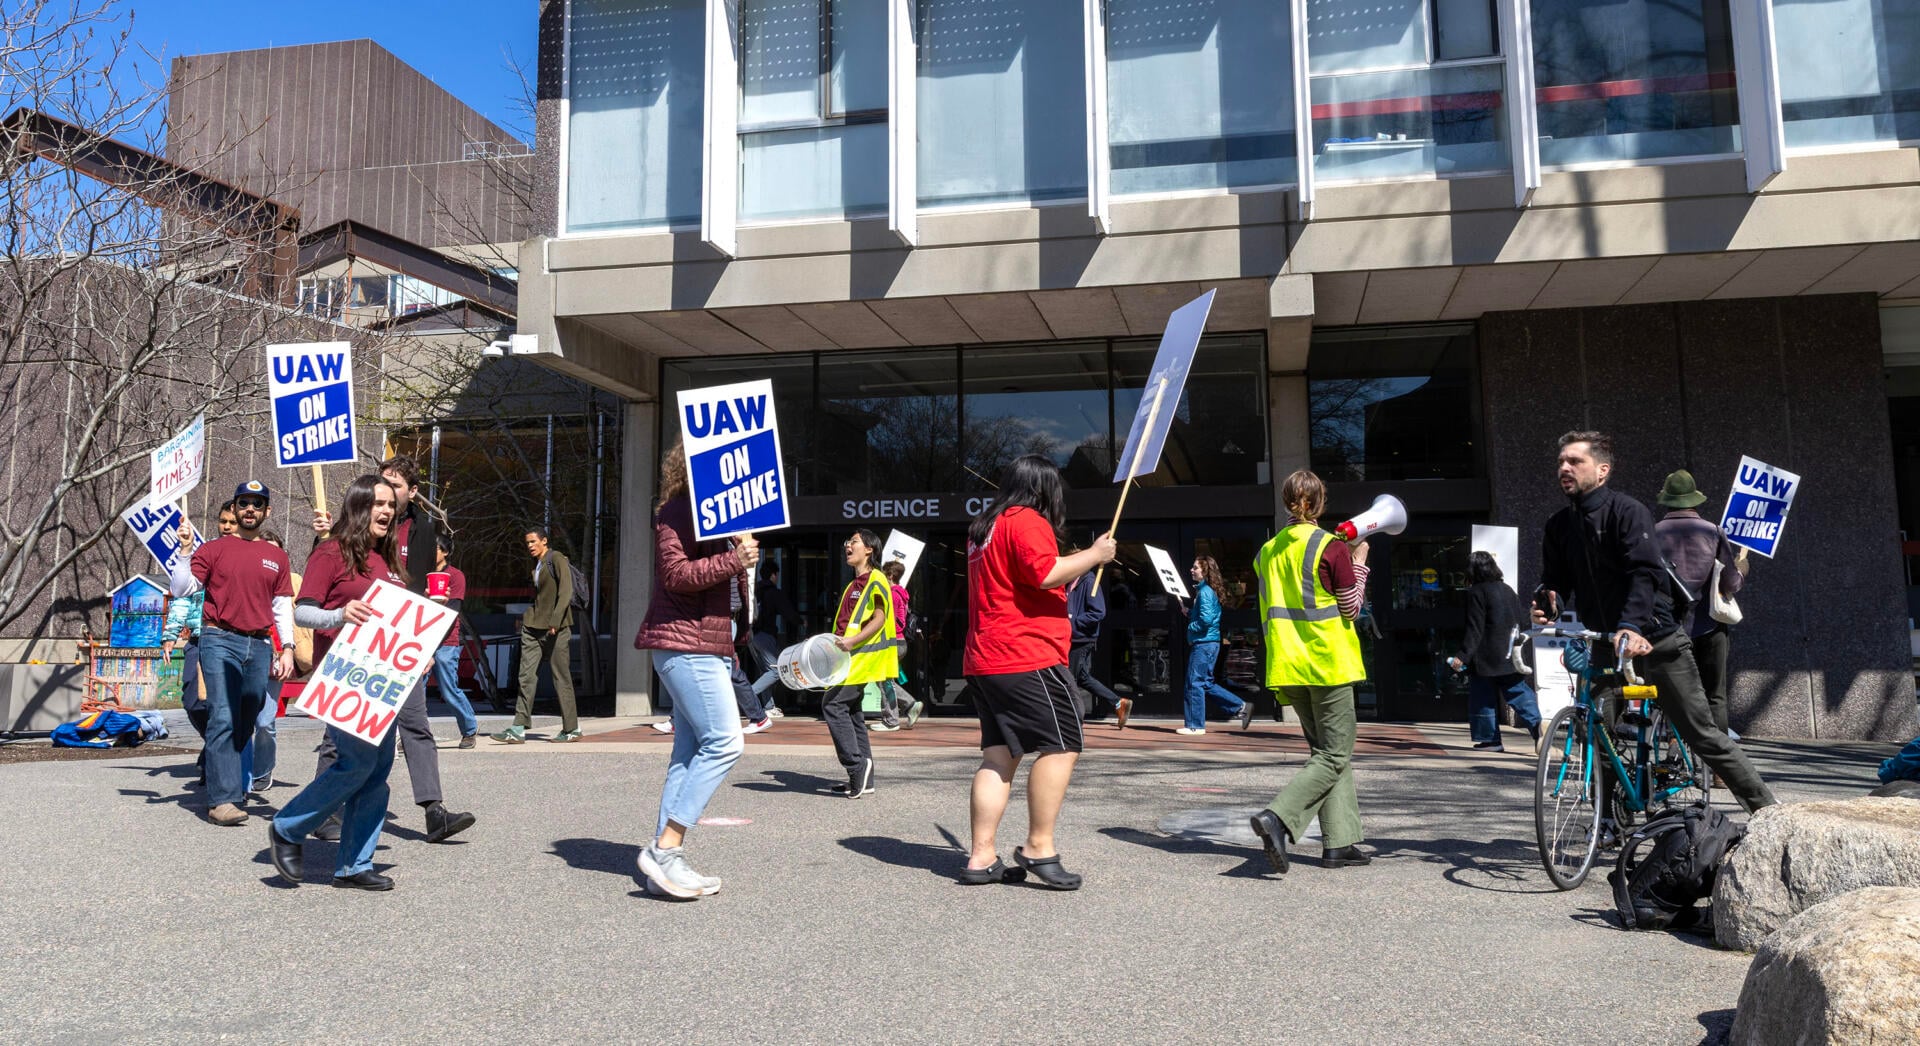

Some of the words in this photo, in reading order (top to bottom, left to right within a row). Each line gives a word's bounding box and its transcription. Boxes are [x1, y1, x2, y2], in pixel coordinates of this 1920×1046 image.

[273, 353, 345, 384] UAW
[298, 391, 327, 424] ON
[684, 394, 767, 439] UAW
[281, 413, 349, 460] STRIKE
[156, 460, 192, 494] TIME'S
[719, 444, 751, 486] ON
[1740, 464, 1793, 499] UAW
[700, 468, 779, 531] STRIKE
[842, 499, 940, 519] SCIENCE
[1745, 499, 1769, 519] ON
[1724, 517, 1778, 540] STRIKE
[321, 652, 406, 707] W@GE
[303, 681, 396, 739] NOW
